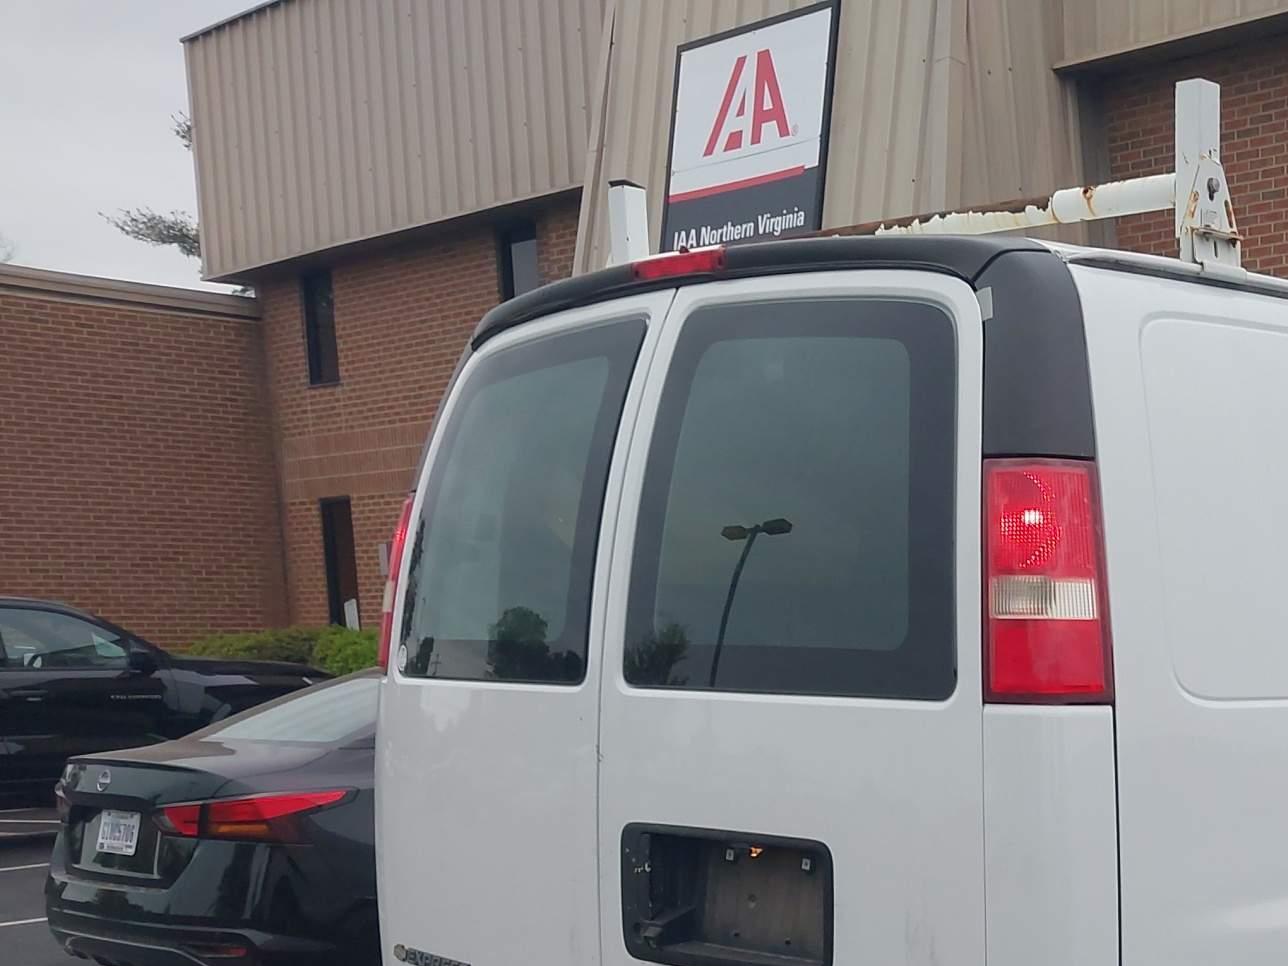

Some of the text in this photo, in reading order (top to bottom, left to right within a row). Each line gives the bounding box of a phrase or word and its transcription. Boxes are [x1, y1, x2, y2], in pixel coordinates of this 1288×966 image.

[673, 206, 805, 251] IAA Northern Virginia
